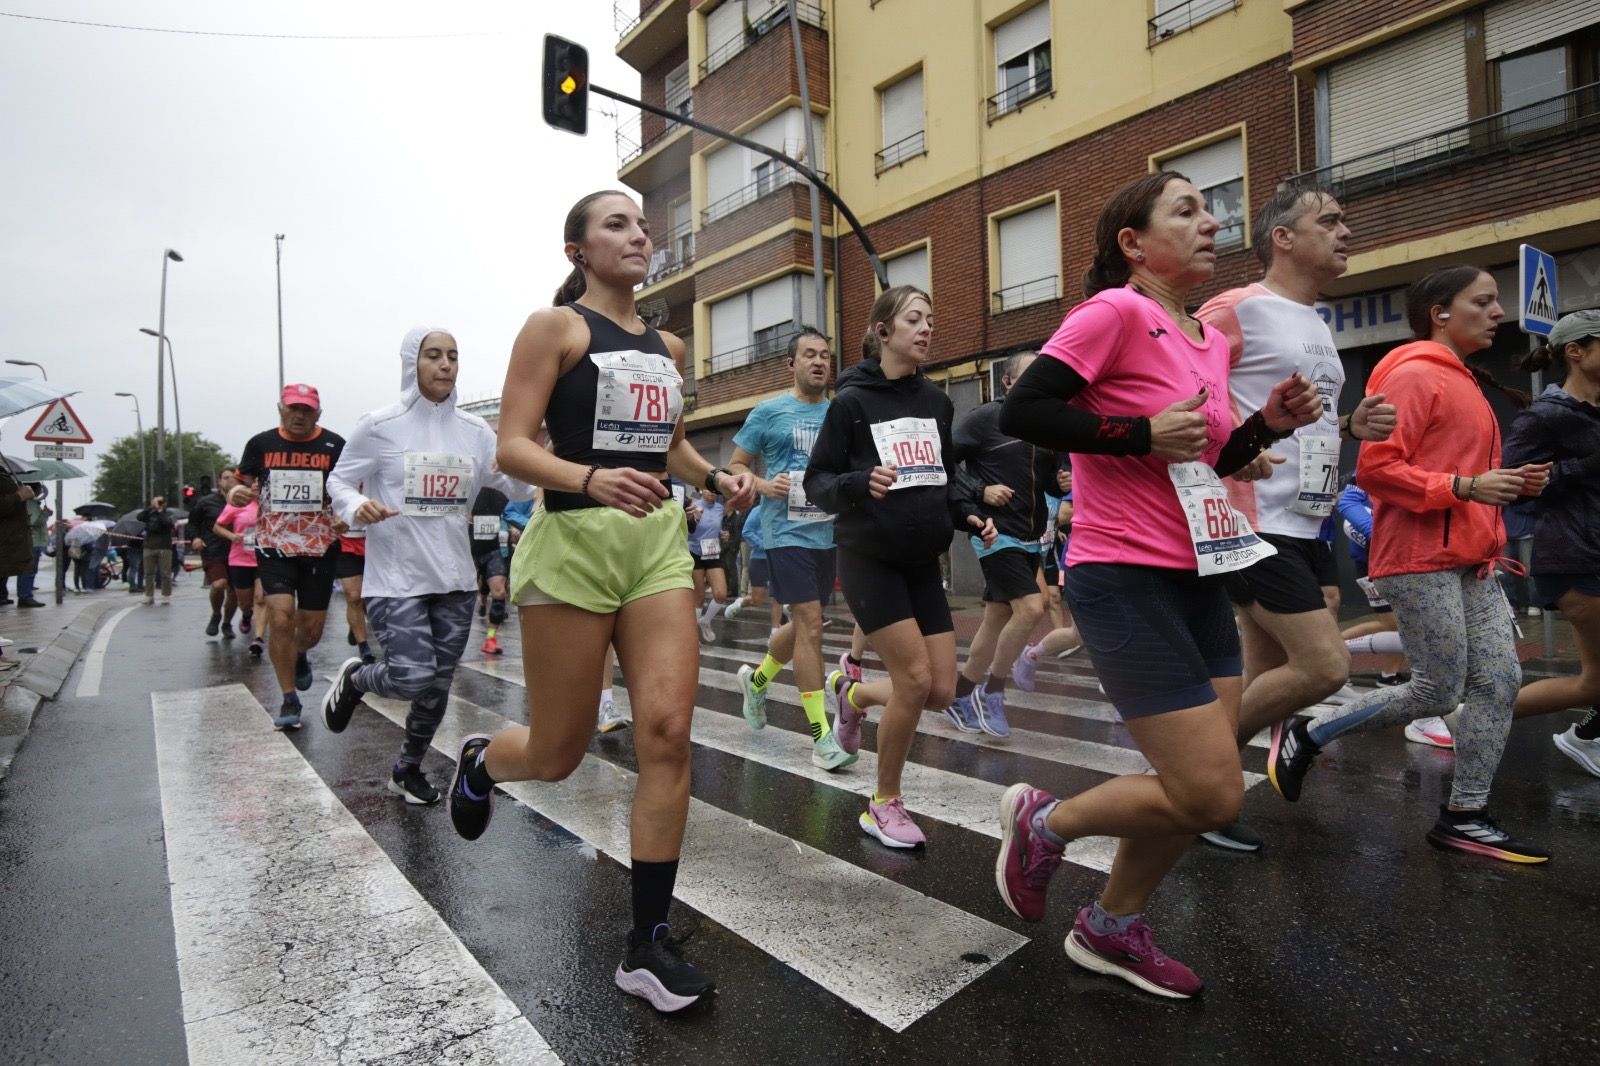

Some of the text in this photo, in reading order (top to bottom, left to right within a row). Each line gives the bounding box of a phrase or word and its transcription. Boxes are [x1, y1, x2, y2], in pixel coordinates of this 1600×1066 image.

[629, 383, 669, 422] 781
[892, 440, 936, 467] 1040
[283, 484, 310, 500] 729
[422, 474, 460, 497] 1132
